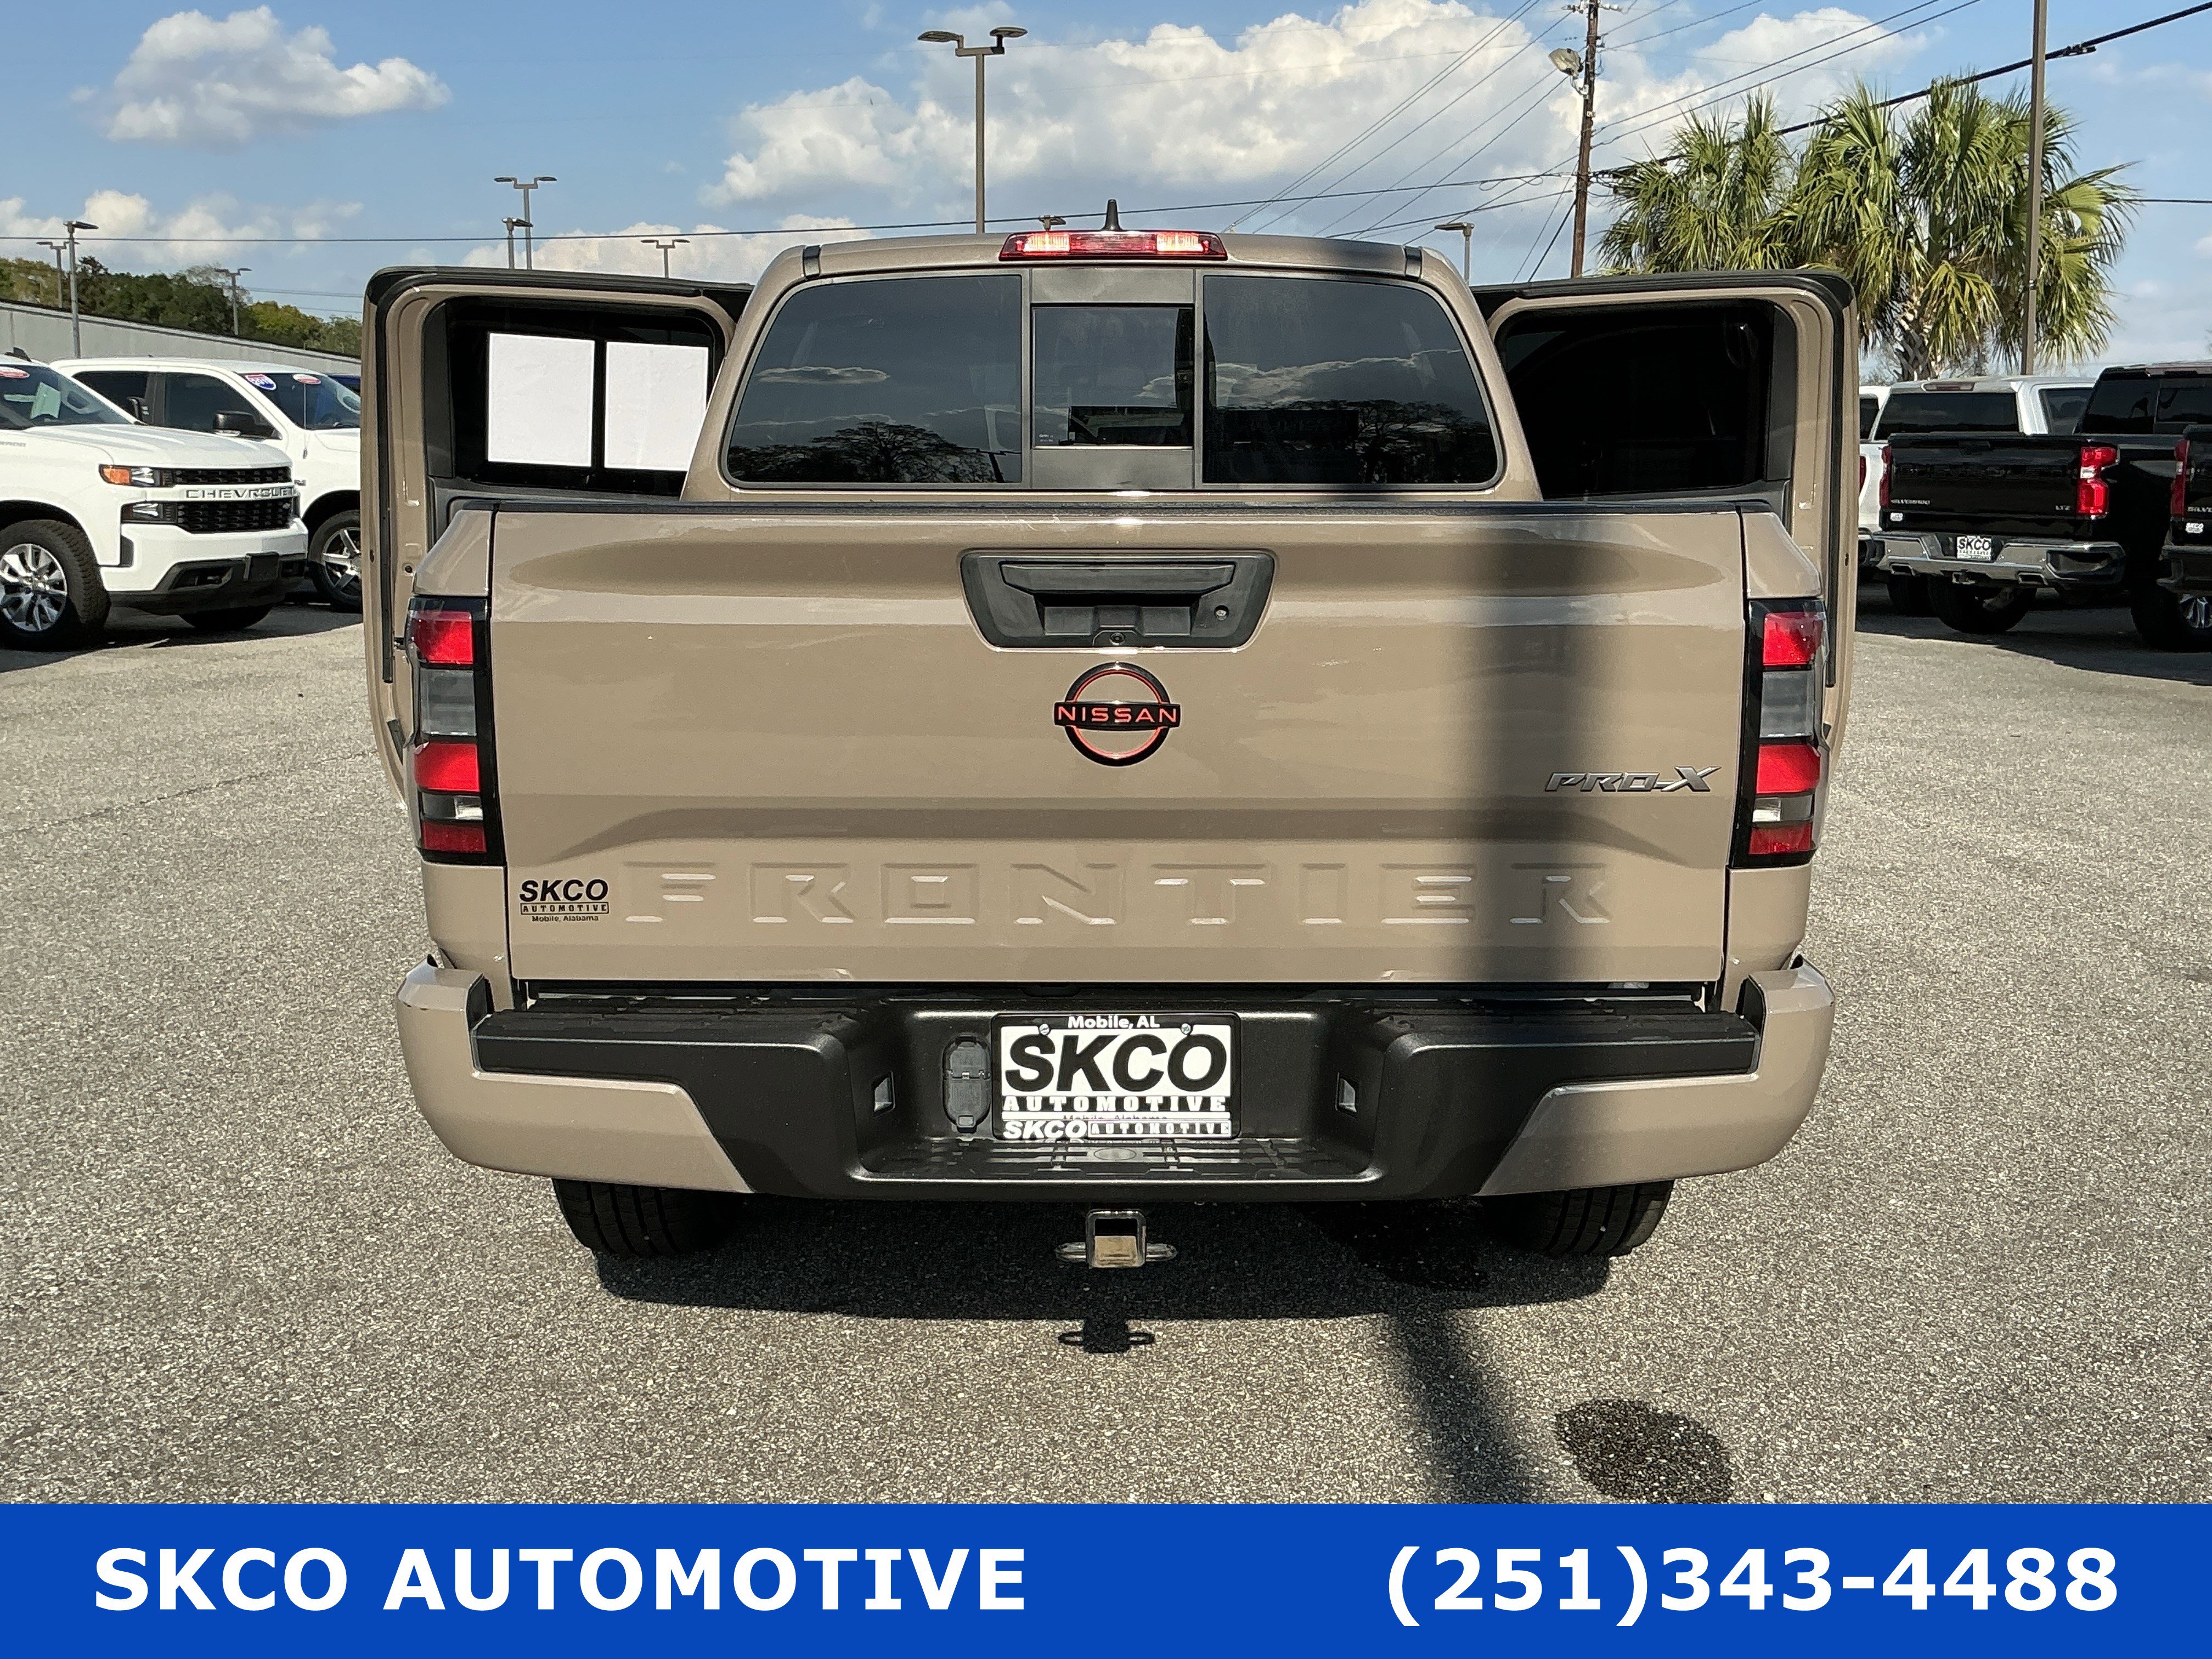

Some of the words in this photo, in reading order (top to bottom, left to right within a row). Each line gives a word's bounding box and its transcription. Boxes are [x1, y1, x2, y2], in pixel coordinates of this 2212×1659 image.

[186, 487, 294, 499] CHEVROLET
[1959, 538, 1991, 551] SKCO
[1058, 706, 1177, 723] NISSAN
[1544, 766, 1722, 792] PRO-X
[519, 878, 609, 902] SKCO
[623, 862, 1612, 924] FRONTIER
[522, 904, 607, 912] AUTOMOTIVE
[1068, 1014, 1134, 1030] Mobile,
[1136, 1015, 1160, 1028] AL
[1005, 1033, 1227, 1092] SKCO
[1003, 1096, 1226, 1112] AUTOMOTIVE
[1003, 1120, 1088, 1139] SKCO
[1091, 1122, 1229, 1135] AUTOMOTIVE
